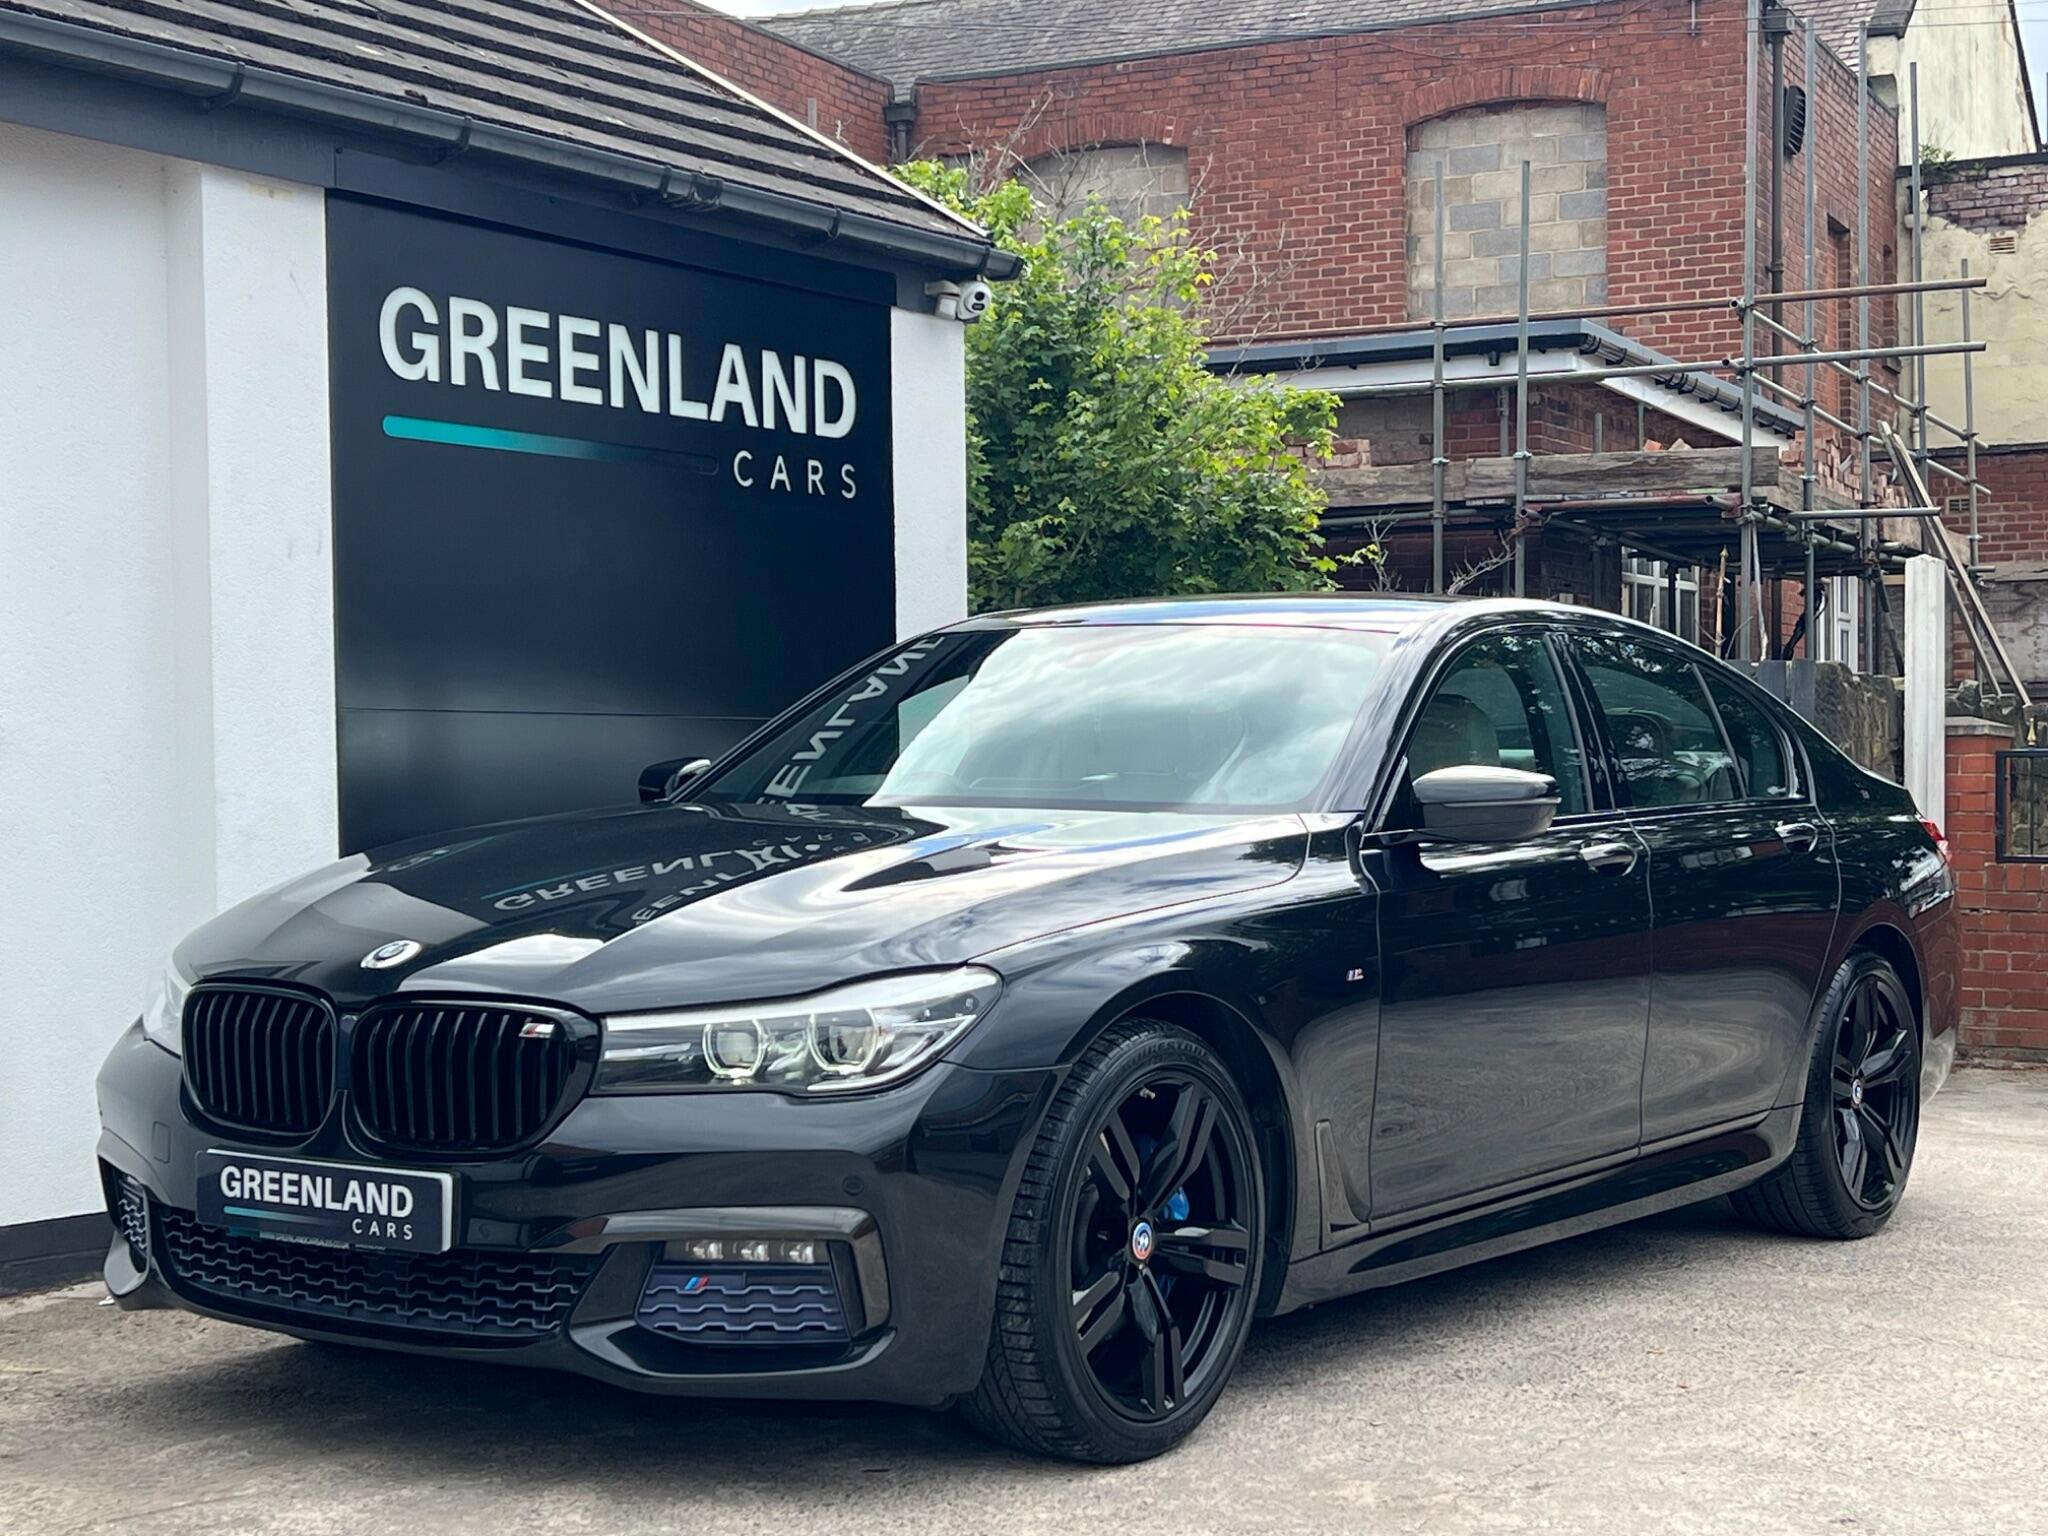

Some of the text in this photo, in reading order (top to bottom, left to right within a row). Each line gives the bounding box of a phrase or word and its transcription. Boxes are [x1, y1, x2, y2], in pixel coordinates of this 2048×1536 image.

[379, 286, 857, 439] GREENLAND
[733, 450, 857, 499] CARS
[220, 1165, 414, 1218] GREENLAND
[352, 1218, 413, 1241] CARS
